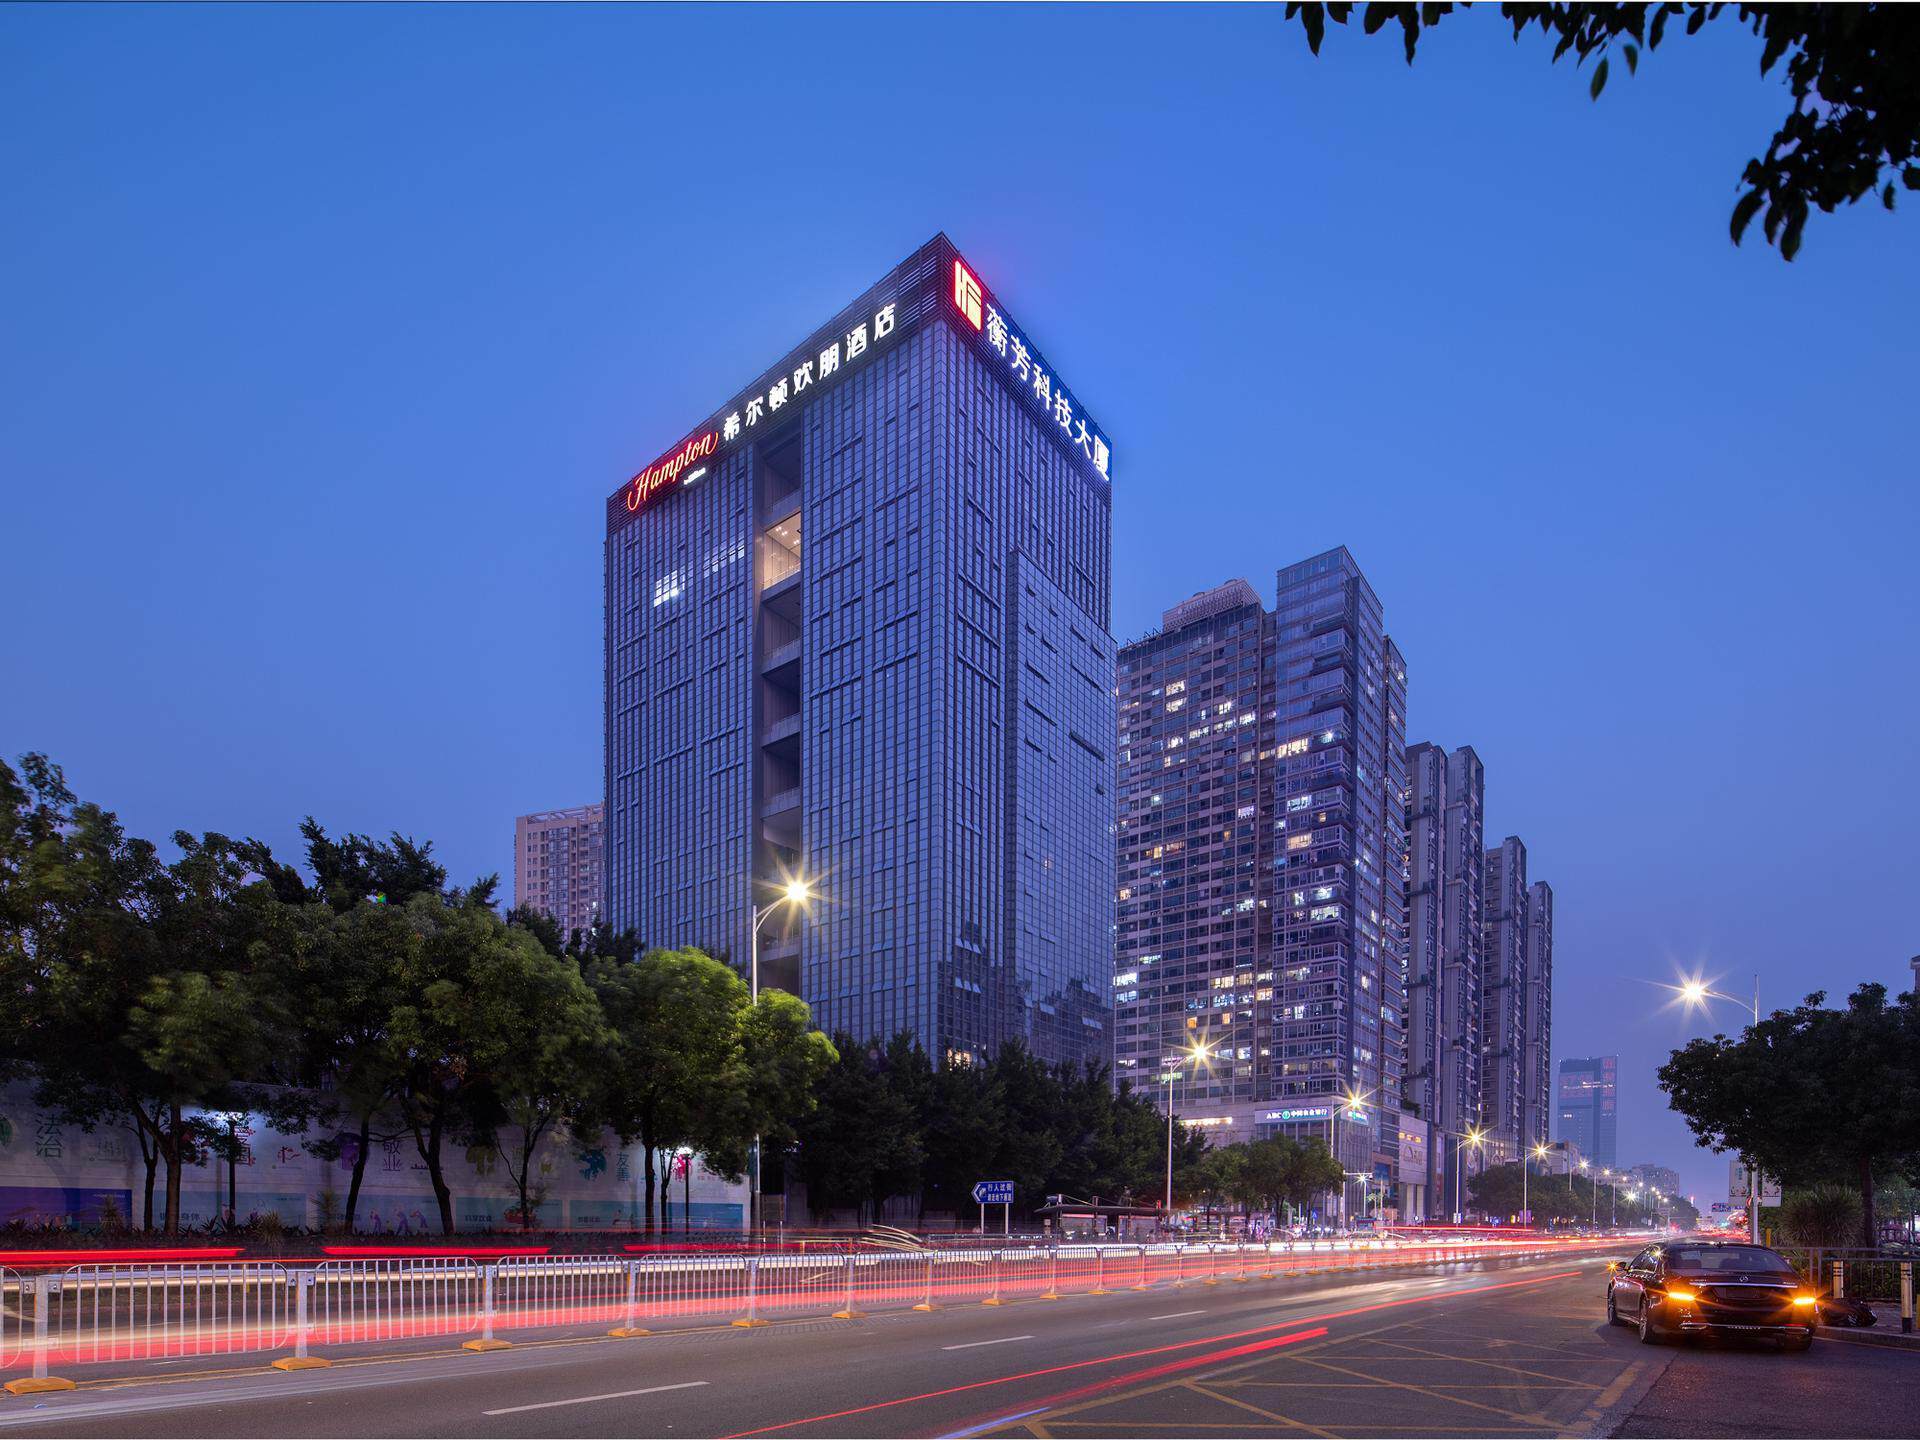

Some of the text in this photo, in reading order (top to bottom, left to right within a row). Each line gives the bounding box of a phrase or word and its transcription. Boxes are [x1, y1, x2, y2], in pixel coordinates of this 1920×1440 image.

[723, 303, 896, 441] 希尔顿欢朋酒店
[627, 432, 719, 511] Hampton
[35, 1113, 63, 1158] 法治
